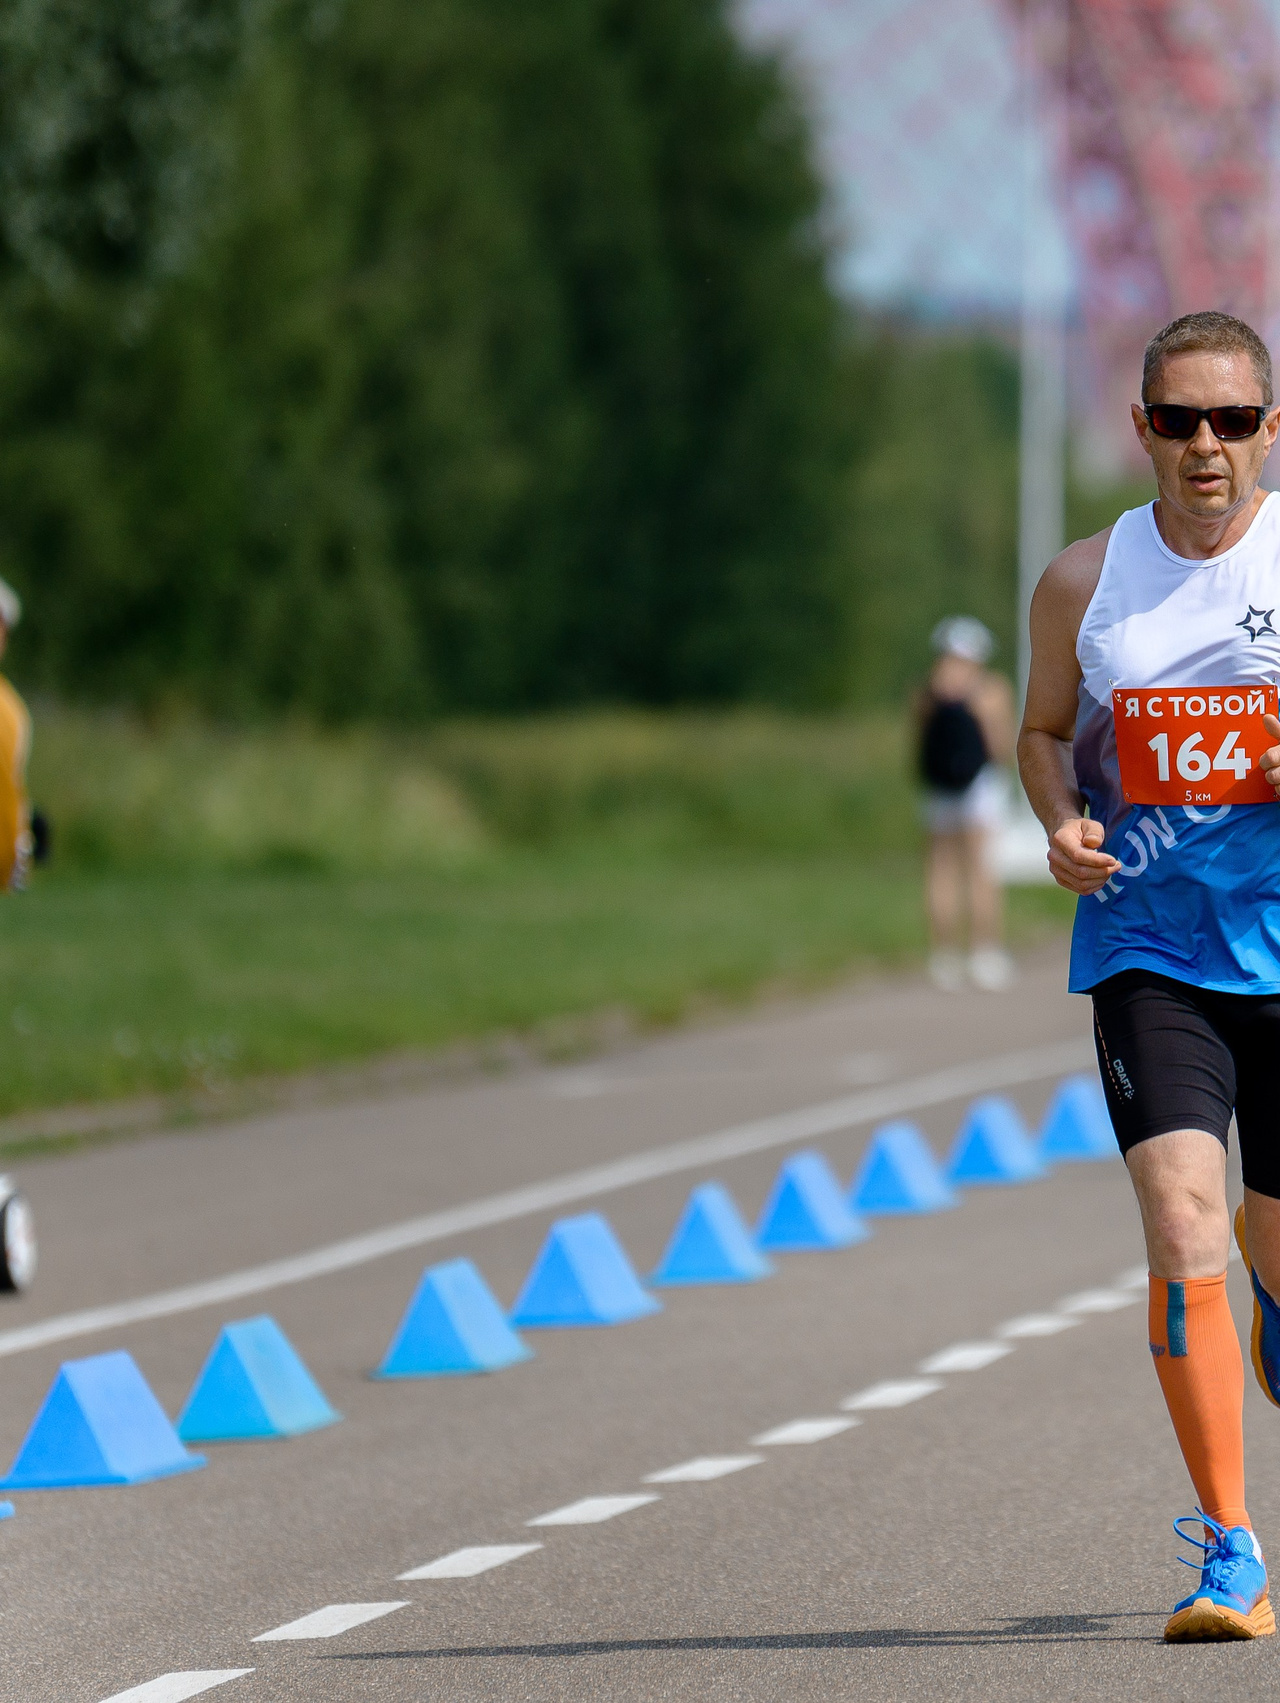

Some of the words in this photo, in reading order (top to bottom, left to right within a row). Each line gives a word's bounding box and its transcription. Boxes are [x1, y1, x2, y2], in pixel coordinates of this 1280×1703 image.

[1125, 697, 1140, 717] Я
[1146, 697, 1164, 717] С
[1168, 690, 1265, 717] ТОБОЙ
[1147, 731, 1252, 782] 164
[1185, 790, 1193, 802] 5
[1113, 1059, 1132, 1089] CRAFT
